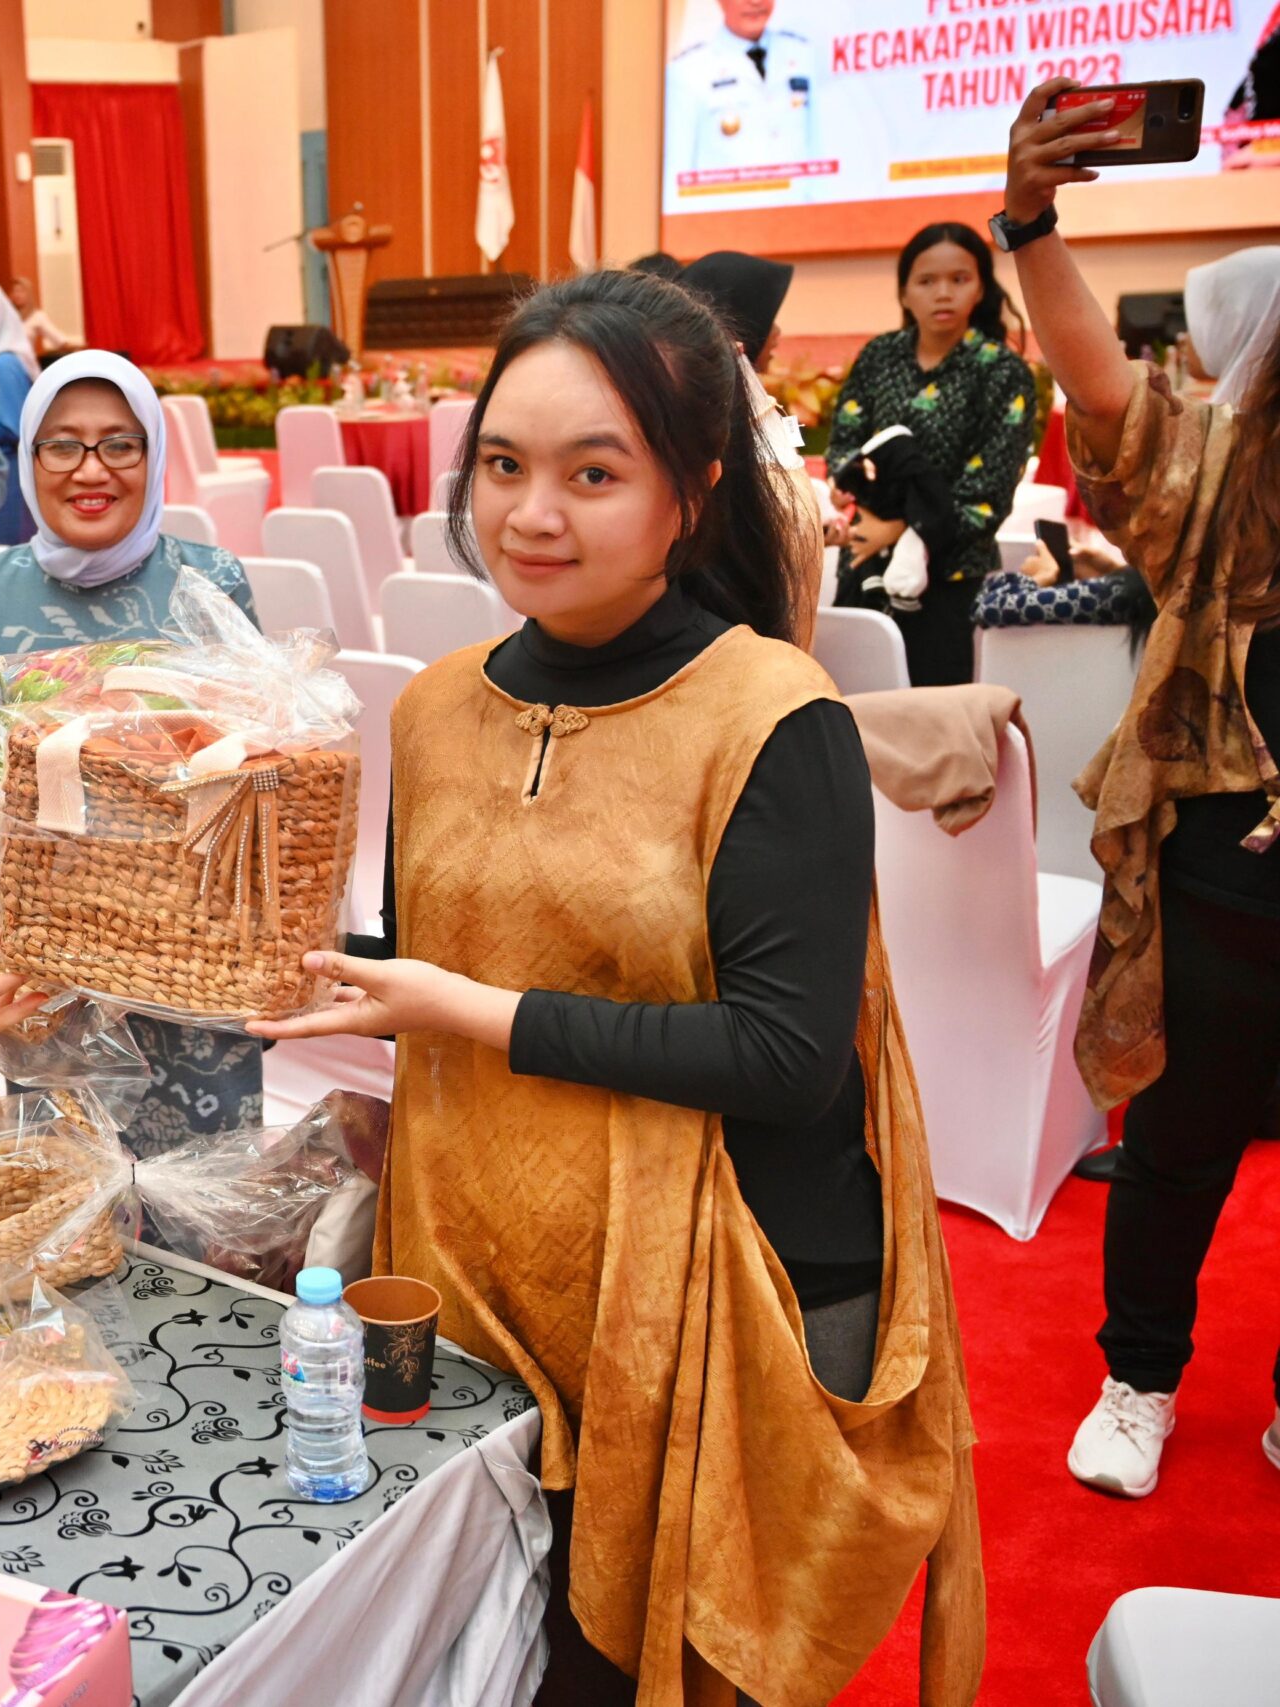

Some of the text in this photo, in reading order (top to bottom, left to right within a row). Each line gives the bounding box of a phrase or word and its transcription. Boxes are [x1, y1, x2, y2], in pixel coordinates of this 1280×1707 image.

[832, 0, 1233, 72] KECAKAPAN WIRAUSAHA
[923, 64, 1025, 110] TAHUN
[362, 1356, 386, 1369] offee
